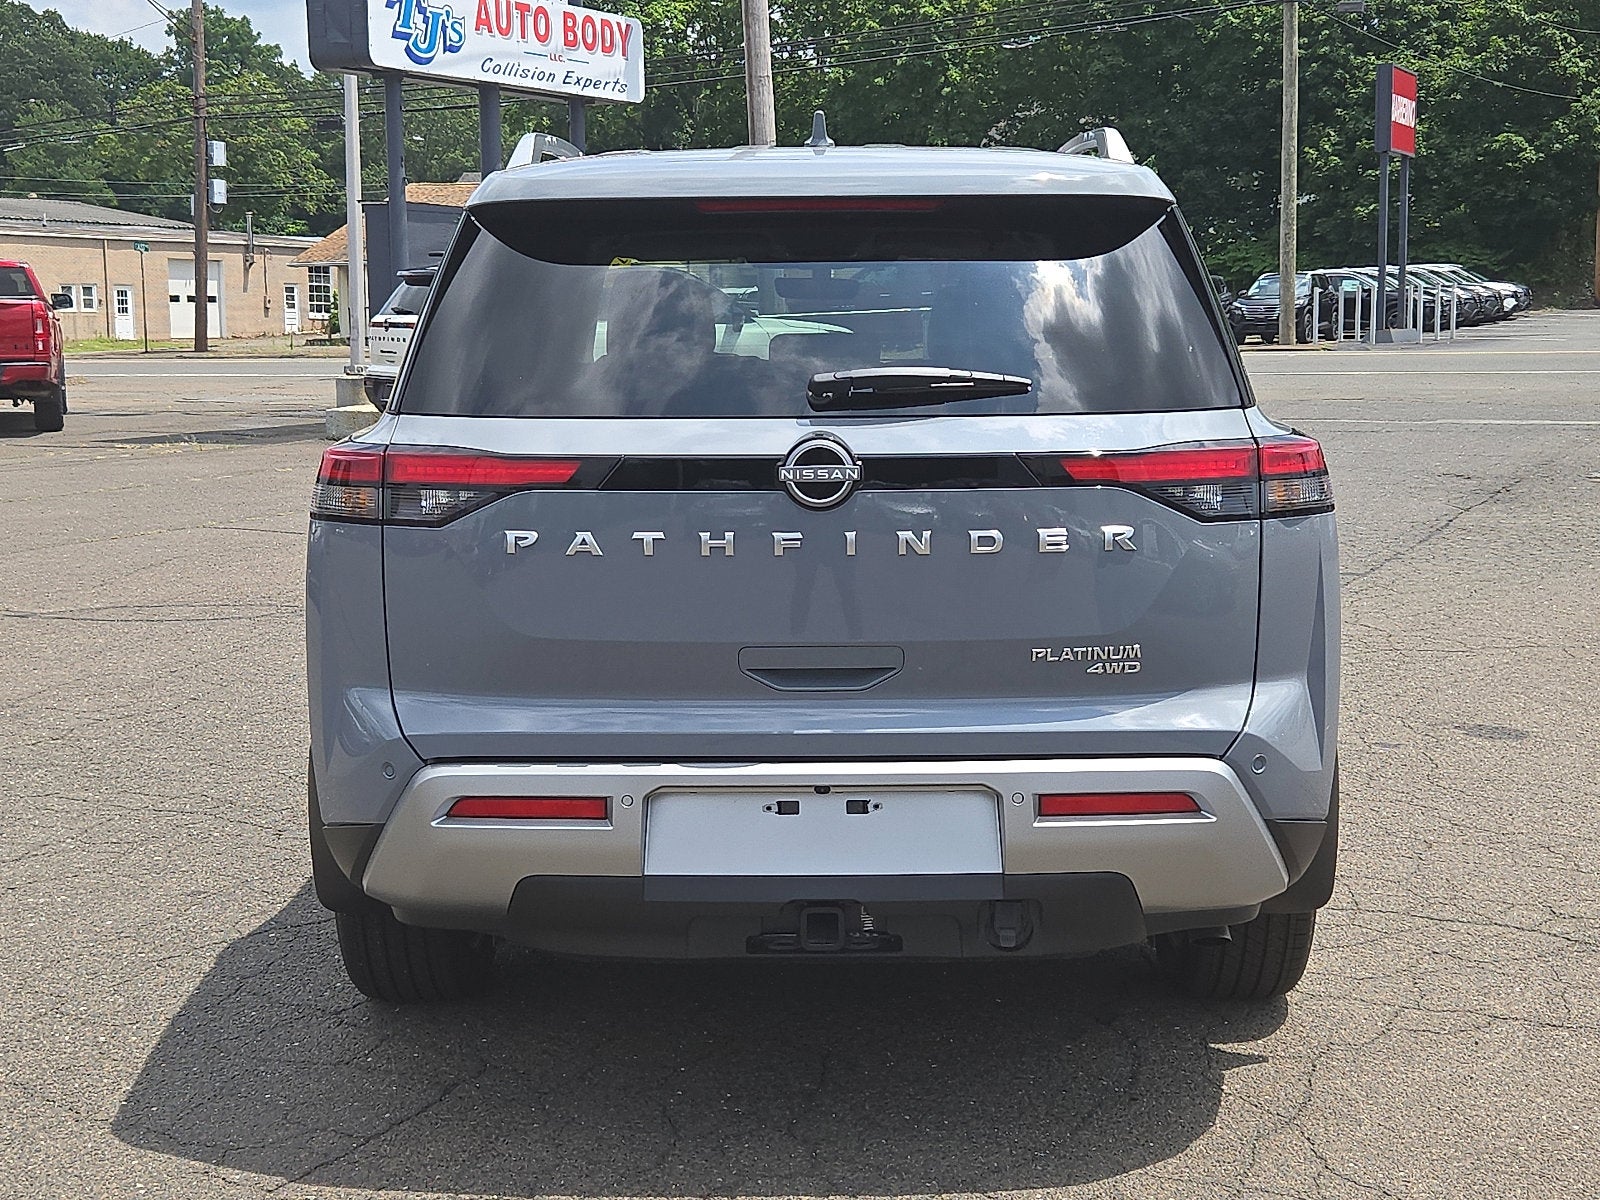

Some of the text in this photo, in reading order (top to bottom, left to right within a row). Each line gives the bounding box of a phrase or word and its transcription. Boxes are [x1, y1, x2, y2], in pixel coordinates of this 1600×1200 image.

[385, 0, 466, 65] TJ's
[475, 0, 632, 58] AUTO BODY
[481, 57, 628, 94] Collision Experts
[780, 468, 859, 480] NISSAN
[504, 525, 1137, 556] PATHFINDER
[1031, 643, 1142, 662] PLATINUM
[1086, 661, 1141, 675] 4WD
